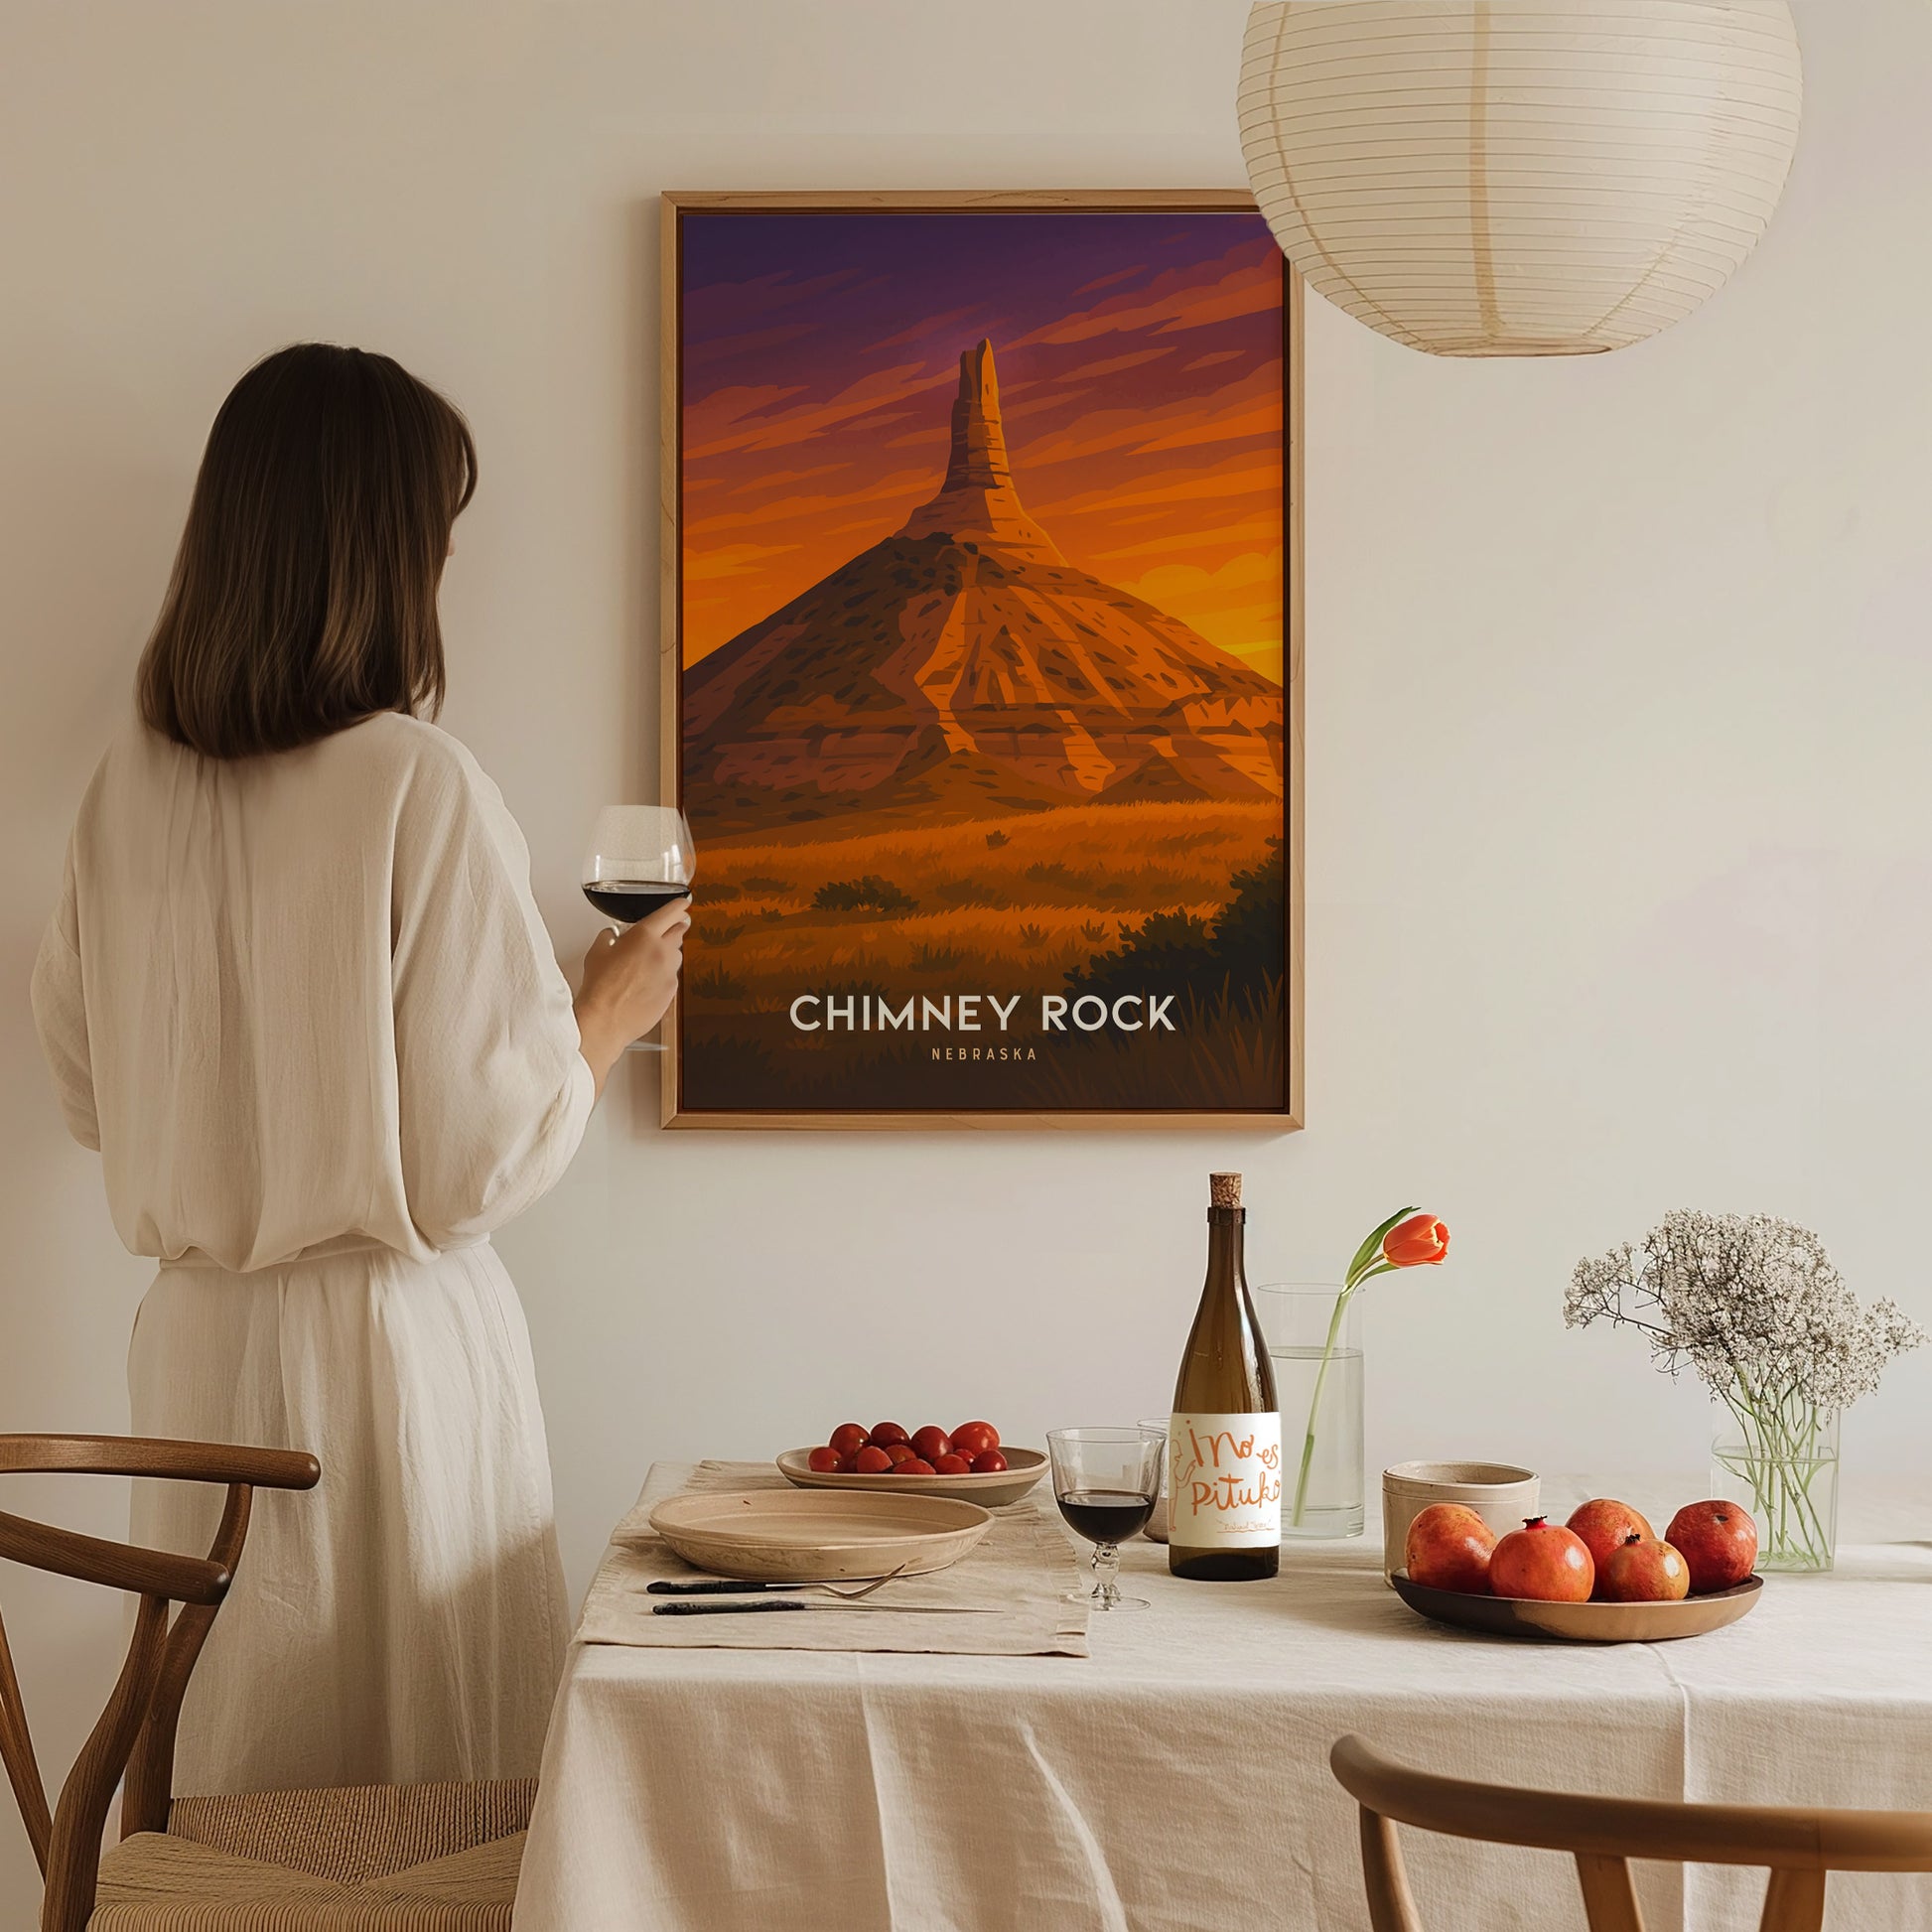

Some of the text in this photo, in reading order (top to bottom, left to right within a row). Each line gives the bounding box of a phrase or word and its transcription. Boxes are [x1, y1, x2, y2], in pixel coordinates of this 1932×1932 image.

[789, 995, 1176, 1032] CHIMNEY ROCK
[931, 1047, 1036, 1061] NEBRASKA
[1256, 1444, 1279, 1469] es
